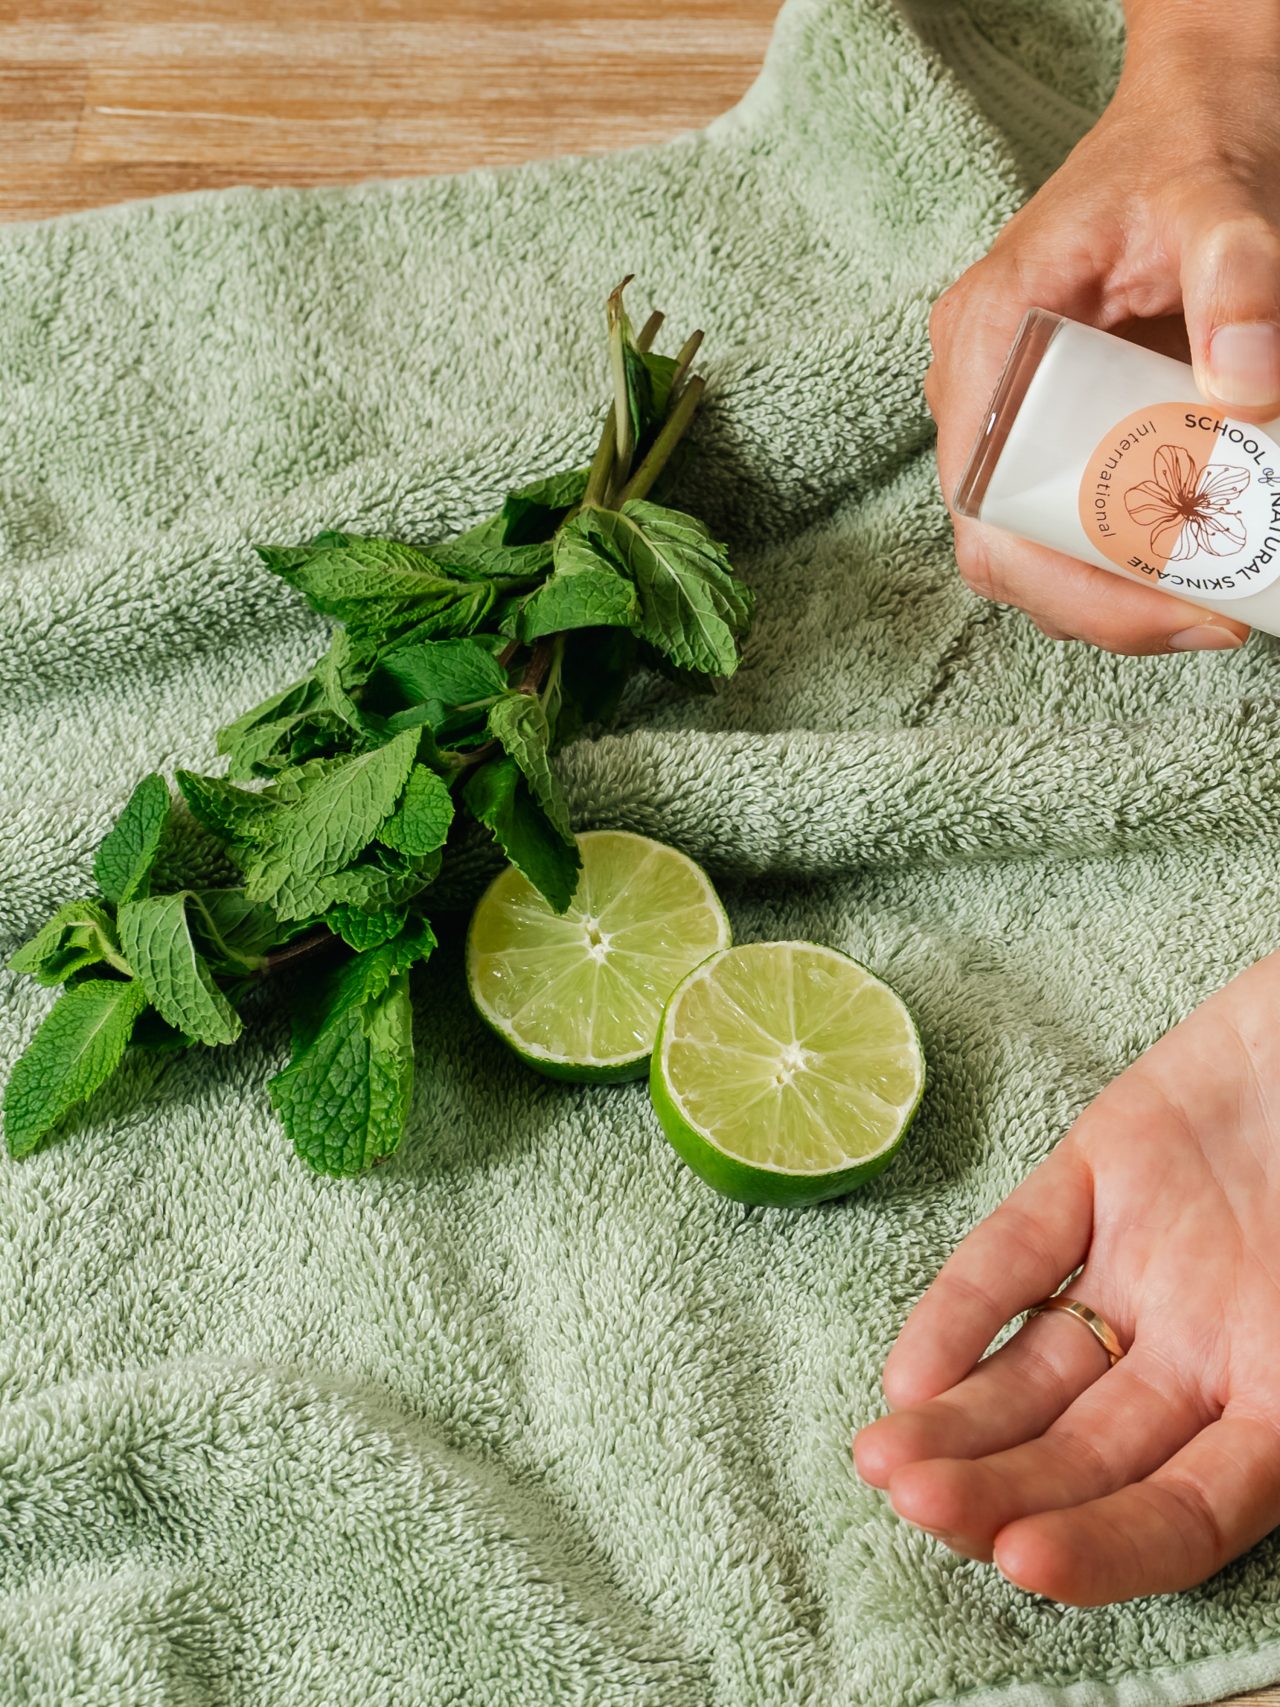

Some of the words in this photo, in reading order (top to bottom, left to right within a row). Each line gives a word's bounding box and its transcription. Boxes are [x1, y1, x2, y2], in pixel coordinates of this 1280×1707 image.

[1184, 413, 1266, 466] SCHOOL
[1094, 420, 1157, 538] International
[1127, 556, 1236, 590] SKINCARE
